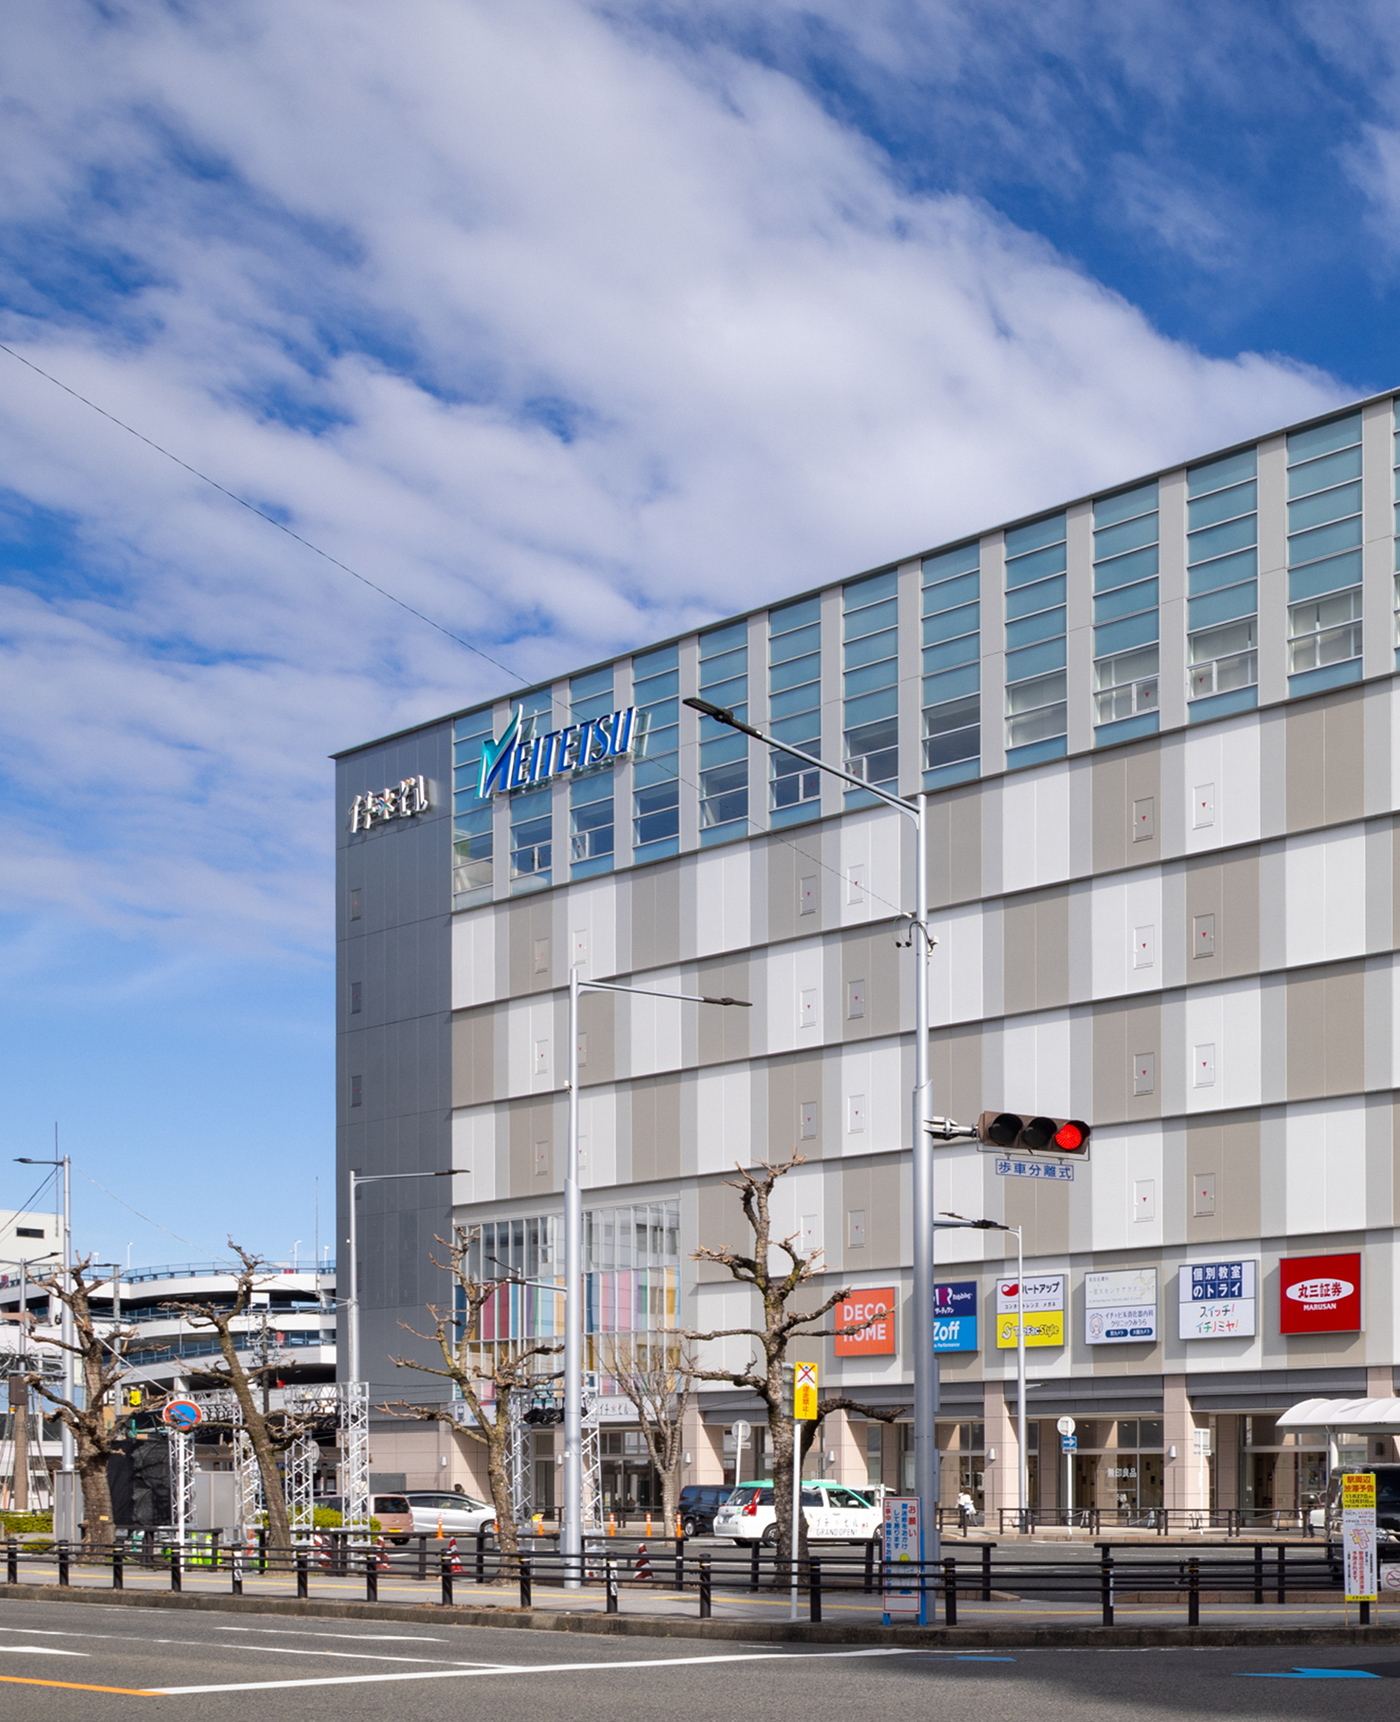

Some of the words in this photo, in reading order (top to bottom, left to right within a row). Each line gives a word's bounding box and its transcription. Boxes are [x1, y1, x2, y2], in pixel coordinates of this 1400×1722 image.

[475, 703, 640, 799] MEITETSU
[998, 1162, 1072, 1179] 歩車分離式
[1193, 1265, 1242, 1281] 個別教室
[1193, 1282, 1240, 1297] のトライ
[1298, 1281, 1342, 1299] 丸三証券
[844, 1303, 886, 1321] DECO
[1303, 1303, 1336, 1311] MARUSAN
[933, 1320, 960, 1341] Zoff
[1107, 1467, 1137, 1478] 無印良品
[908, 1505, 916, 1537] お願い
